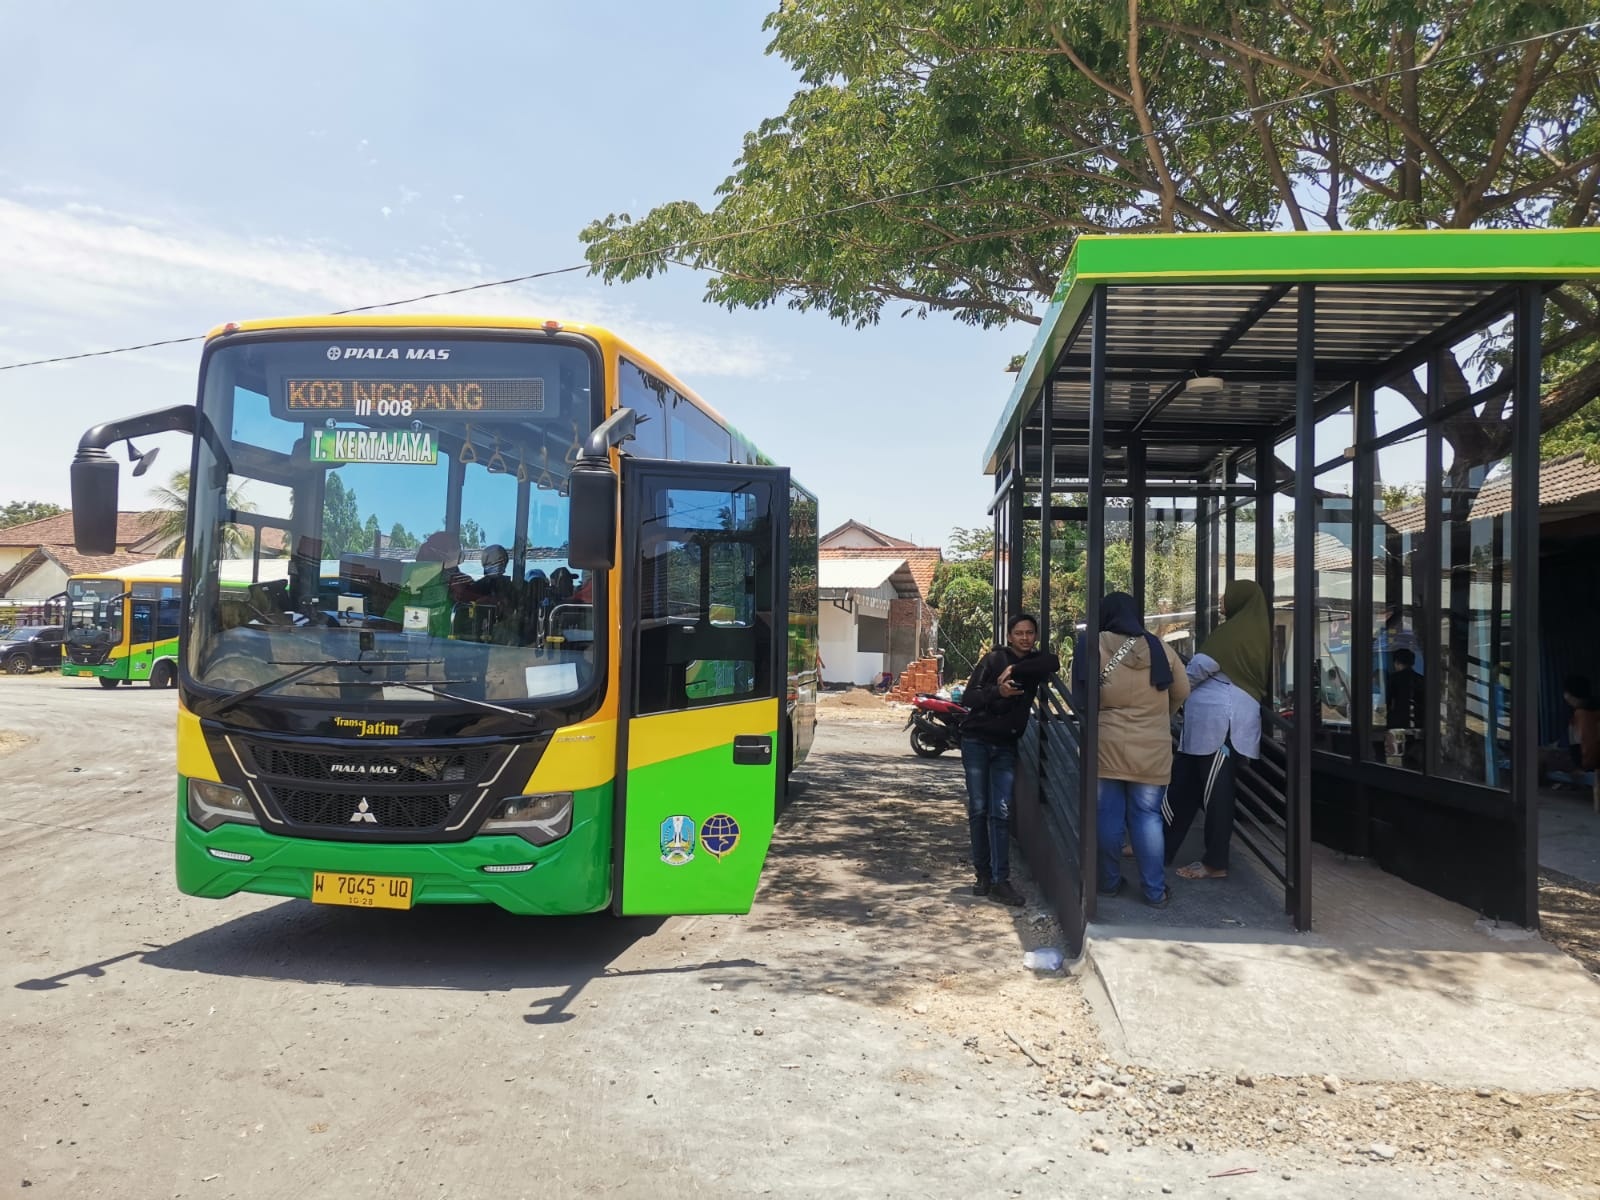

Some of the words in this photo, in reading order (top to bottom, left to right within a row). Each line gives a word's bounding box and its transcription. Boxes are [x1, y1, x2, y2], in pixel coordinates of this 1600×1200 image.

[344, 348, 399, 359] PIALA
[405, 348, 451, 360] MAS
[377, 400, 412, 416] 008
[314, 430, 327, 459] T.
[335, 430, 433, 462] KERTAJAYA
[334, 717, 358, 726] Trans
[357, 720, 398, 737] Jatim
[331, 764, 366, 773] PIALA
[369, 765, 398, 774] MAS
[315, 875, 324, 892] W
[338, 877, 375, 895] 7045
